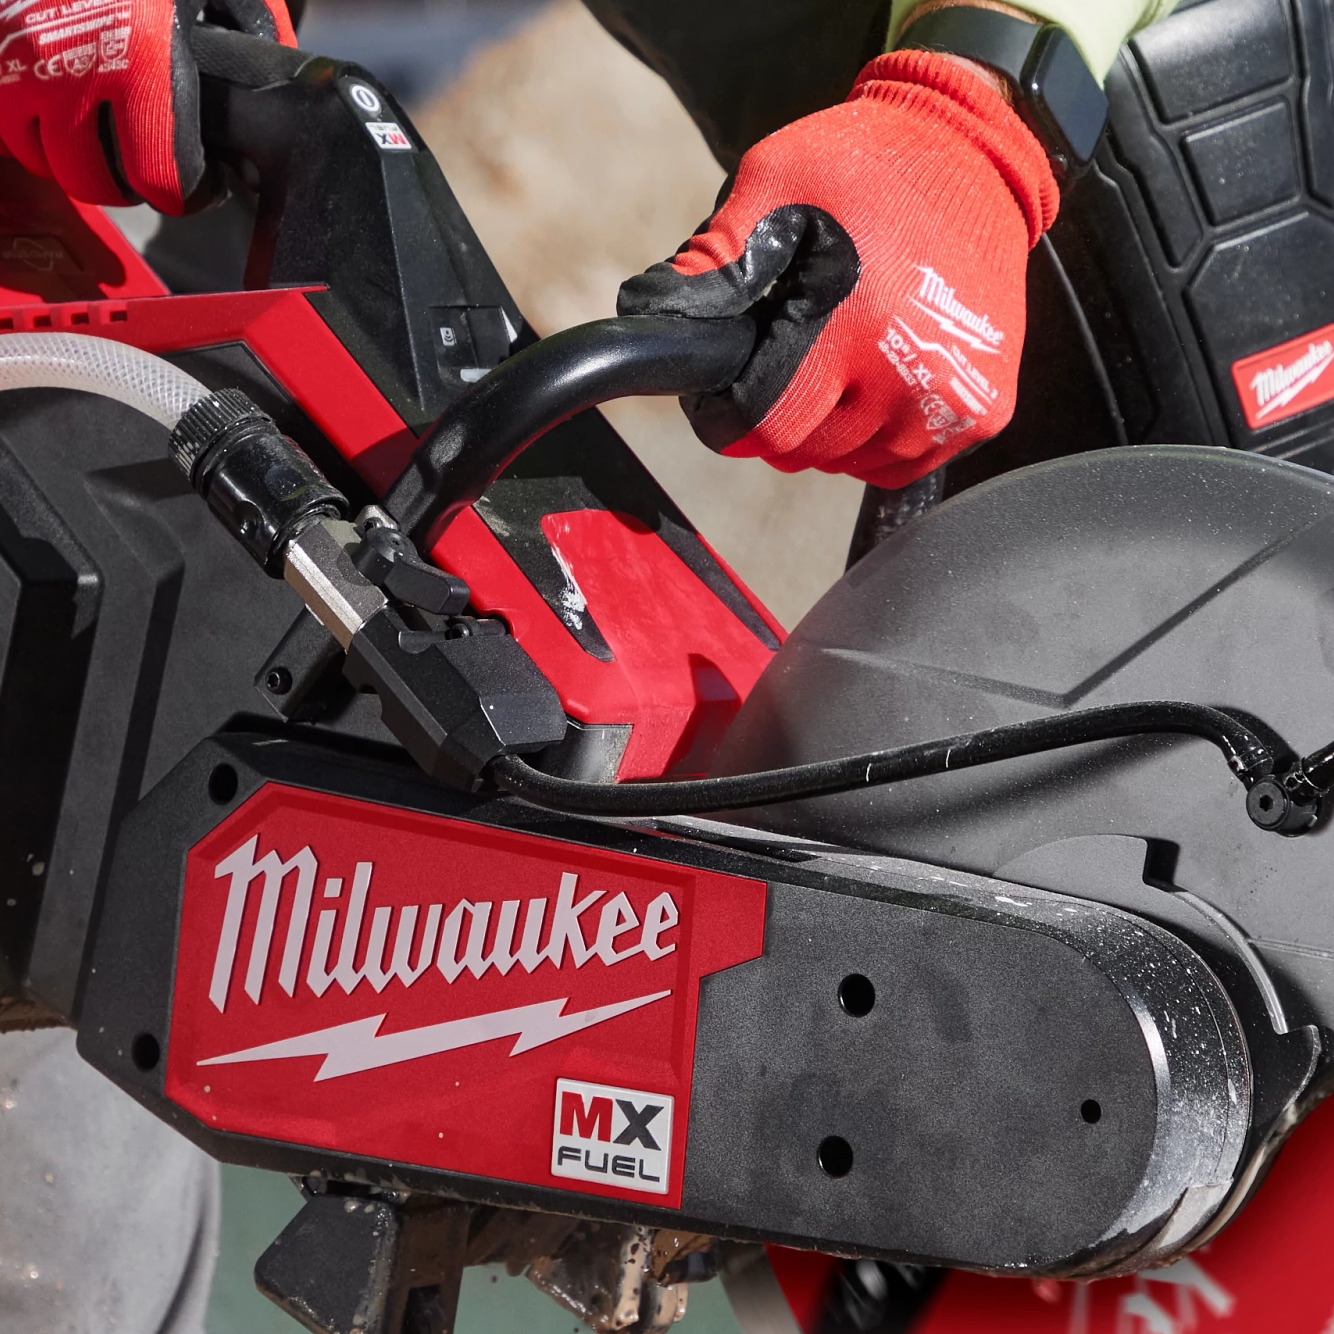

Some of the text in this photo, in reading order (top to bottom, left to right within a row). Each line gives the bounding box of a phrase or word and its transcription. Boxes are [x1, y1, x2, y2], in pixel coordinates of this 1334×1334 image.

[25, 9, 56, 23] CUT
[6, 58, 26, 72] XL
[374, 132, 407, 145] MX
[917, 266, 1003, 345] Milwaukee
[913, 363, 931, 389] XL
[952, 345, 966, 366] CUT
[968, 361, 989, 393] LEVEL
[1249, 340, 1333, 406] Milwaukee
[209, 834, 678, 1013] Milwaukee
[559, 1090, 665, 1152] MX
[557, 1145, 661, 1183] FUEL
